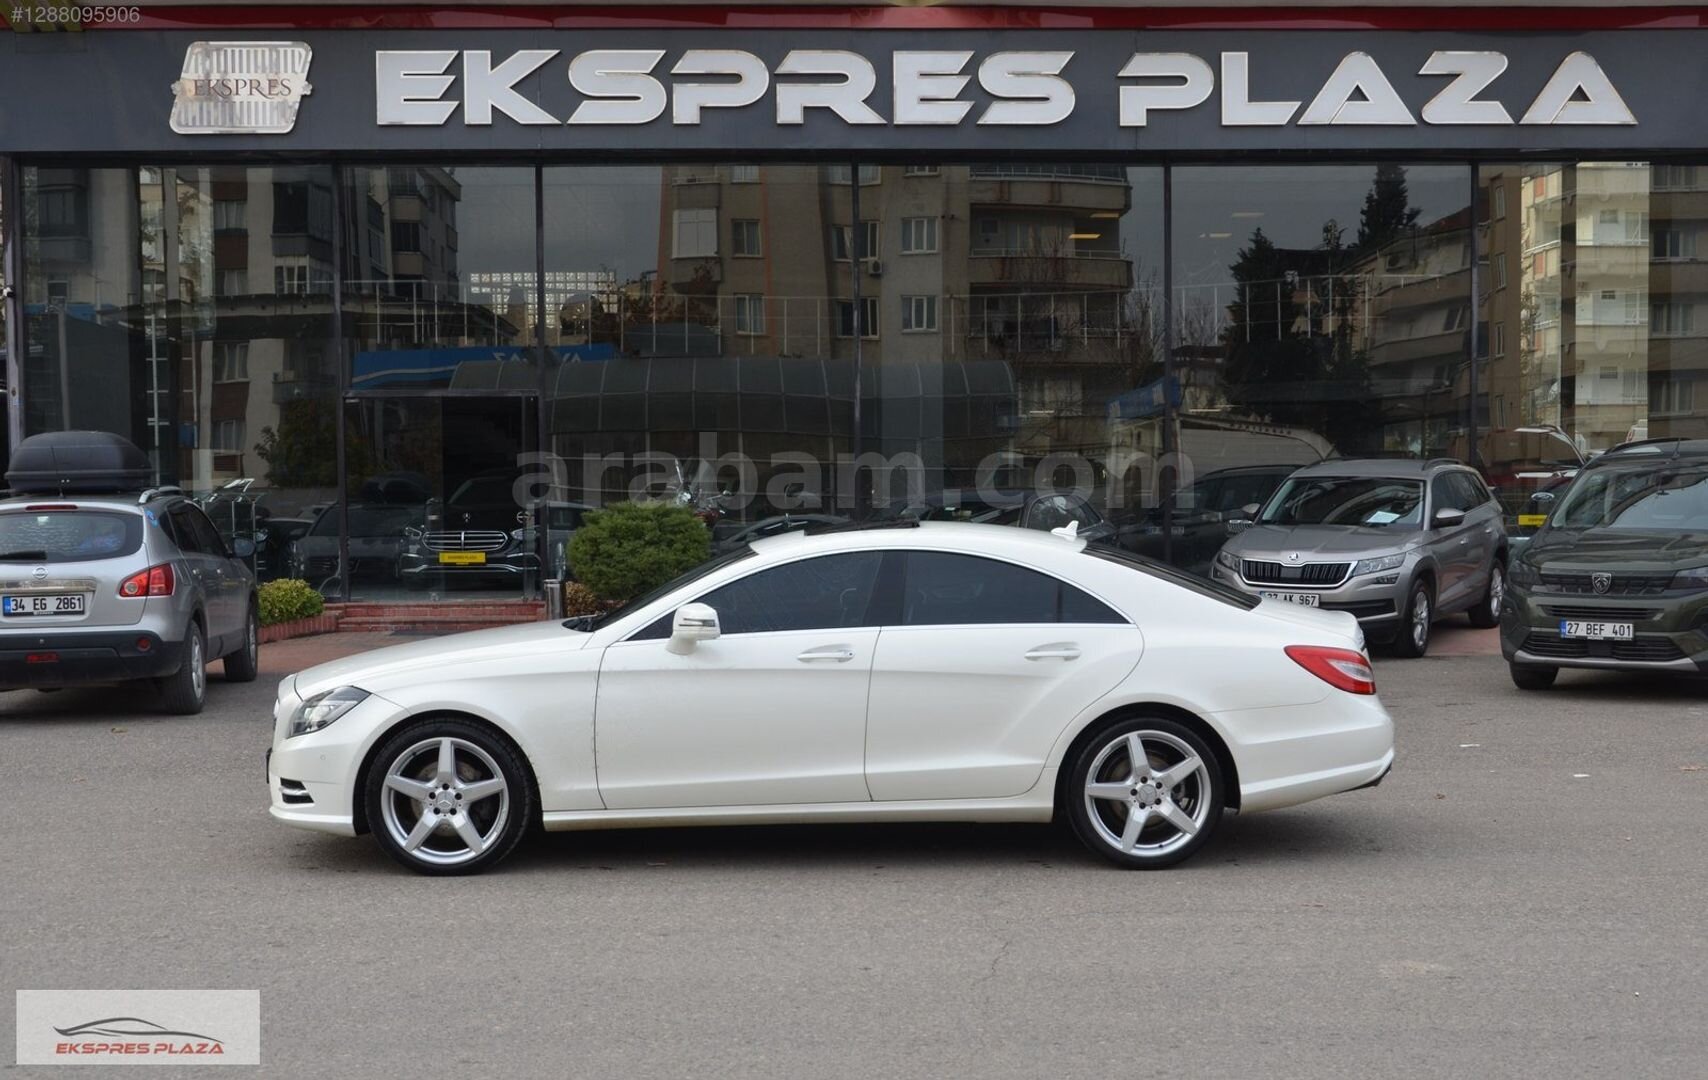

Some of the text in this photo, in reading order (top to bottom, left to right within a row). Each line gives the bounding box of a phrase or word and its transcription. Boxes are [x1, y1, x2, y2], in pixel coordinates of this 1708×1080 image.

[194, 78, 292, 99] EKSPRES
[375, 50, 1638, 127] EKSPRES PLAZA
[11, 597, 82, 611] 34 EG 2861
[1299, 594, 1316, 606] 967
[1567, 622, 1631, 636] 27 BEF 401
